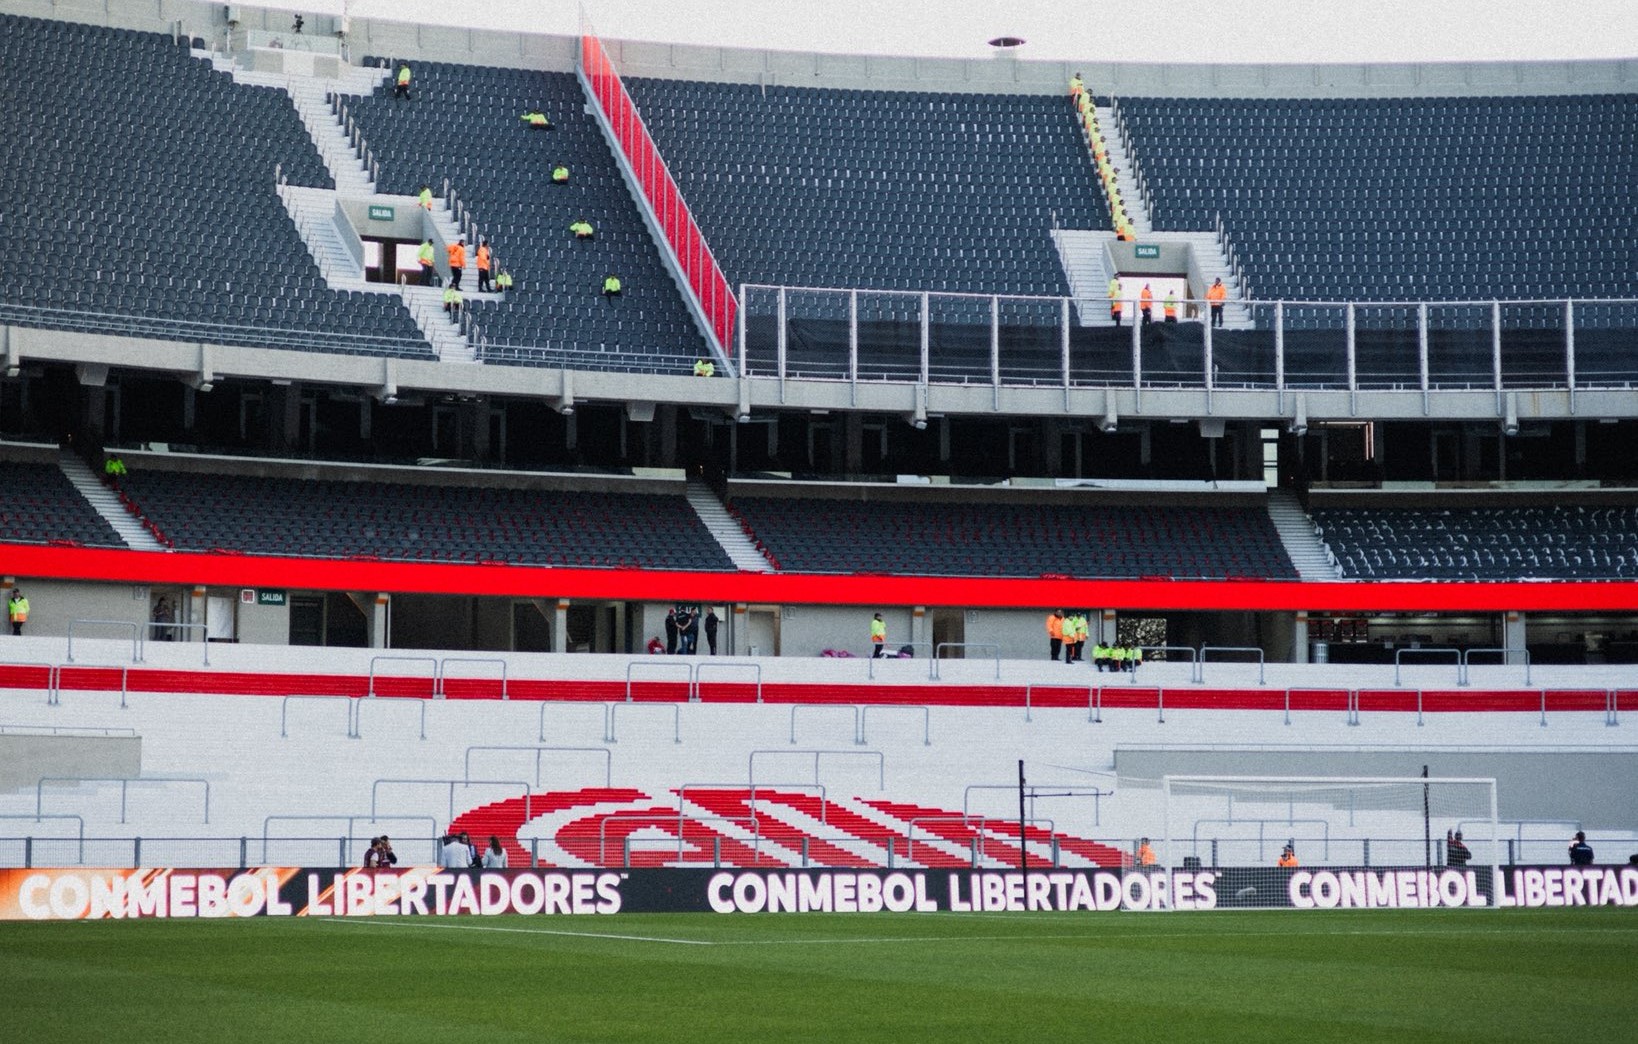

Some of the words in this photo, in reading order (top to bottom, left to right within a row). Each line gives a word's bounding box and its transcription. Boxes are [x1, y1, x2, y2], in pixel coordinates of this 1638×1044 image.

[371, 208, 392, 217] SALIDA
[1137, 247, 1157, 255] SALIDA
[261, 592, 283, 602] SALIDA
[18, 873, 293, 919] CONMEBOL
[707, 871, 938, 913] CONMEBOL
[1289, 870, 1487, 908] CONMEBOL
